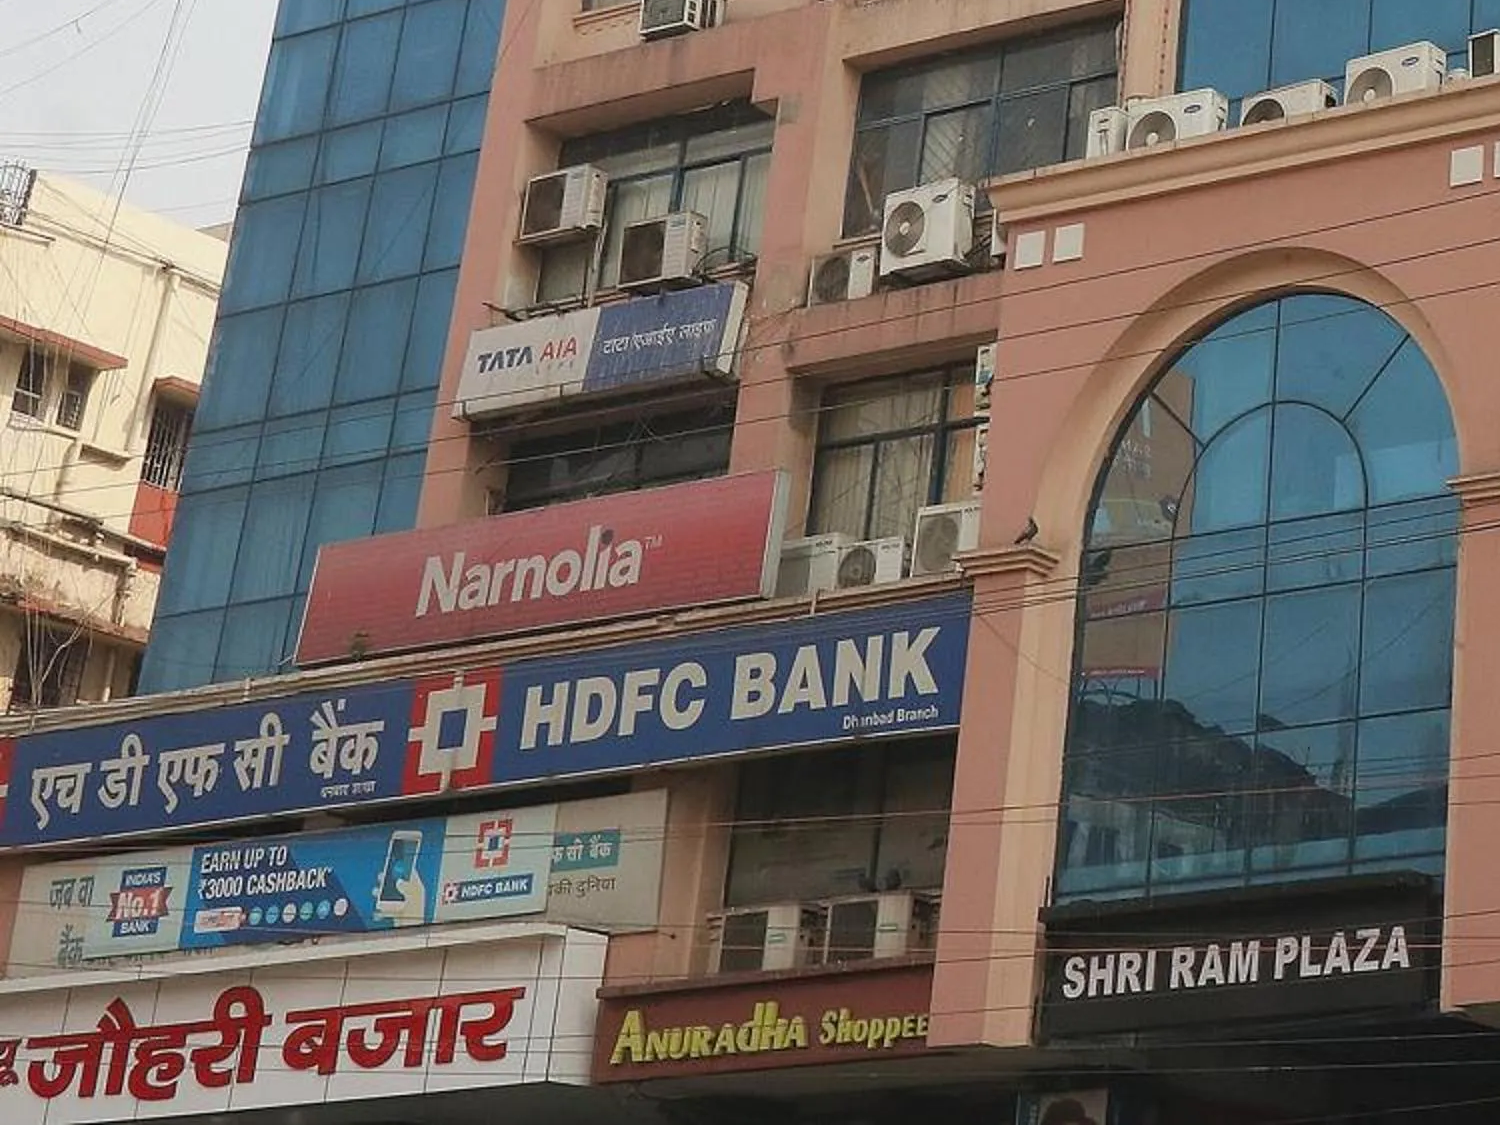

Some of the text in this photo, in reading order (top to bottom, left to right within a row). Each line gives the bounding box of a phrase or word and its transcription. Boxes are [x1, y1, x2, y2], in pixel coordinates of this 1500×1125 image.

[478, 346, 533, 374] TATA
[540, 336, 577, 362] AIA
[603, 336, 629, 354] टाटा
[415, 525, 642, 618] Narnolia
[519, 627, 941, 750] HDFC BANK
[896, 704, 939, 723] Branch
[31, 698, 385, 830] एच डी एफ सी बैंक
[201, 845, 288, 873] EARN UP TO
[124, 870, 162, 886] INDIA'S
[461, 877, 528, 899] HDFC BANK
[115, 890, 160, 920] No.1
[119, 922, 151, 935] BANK
[1062, 926, 1411, 999] SHRI RAM PLAZA
[26, 986, 273, 1102] जौहरी
[282, 987, 526, 1075] बजार
